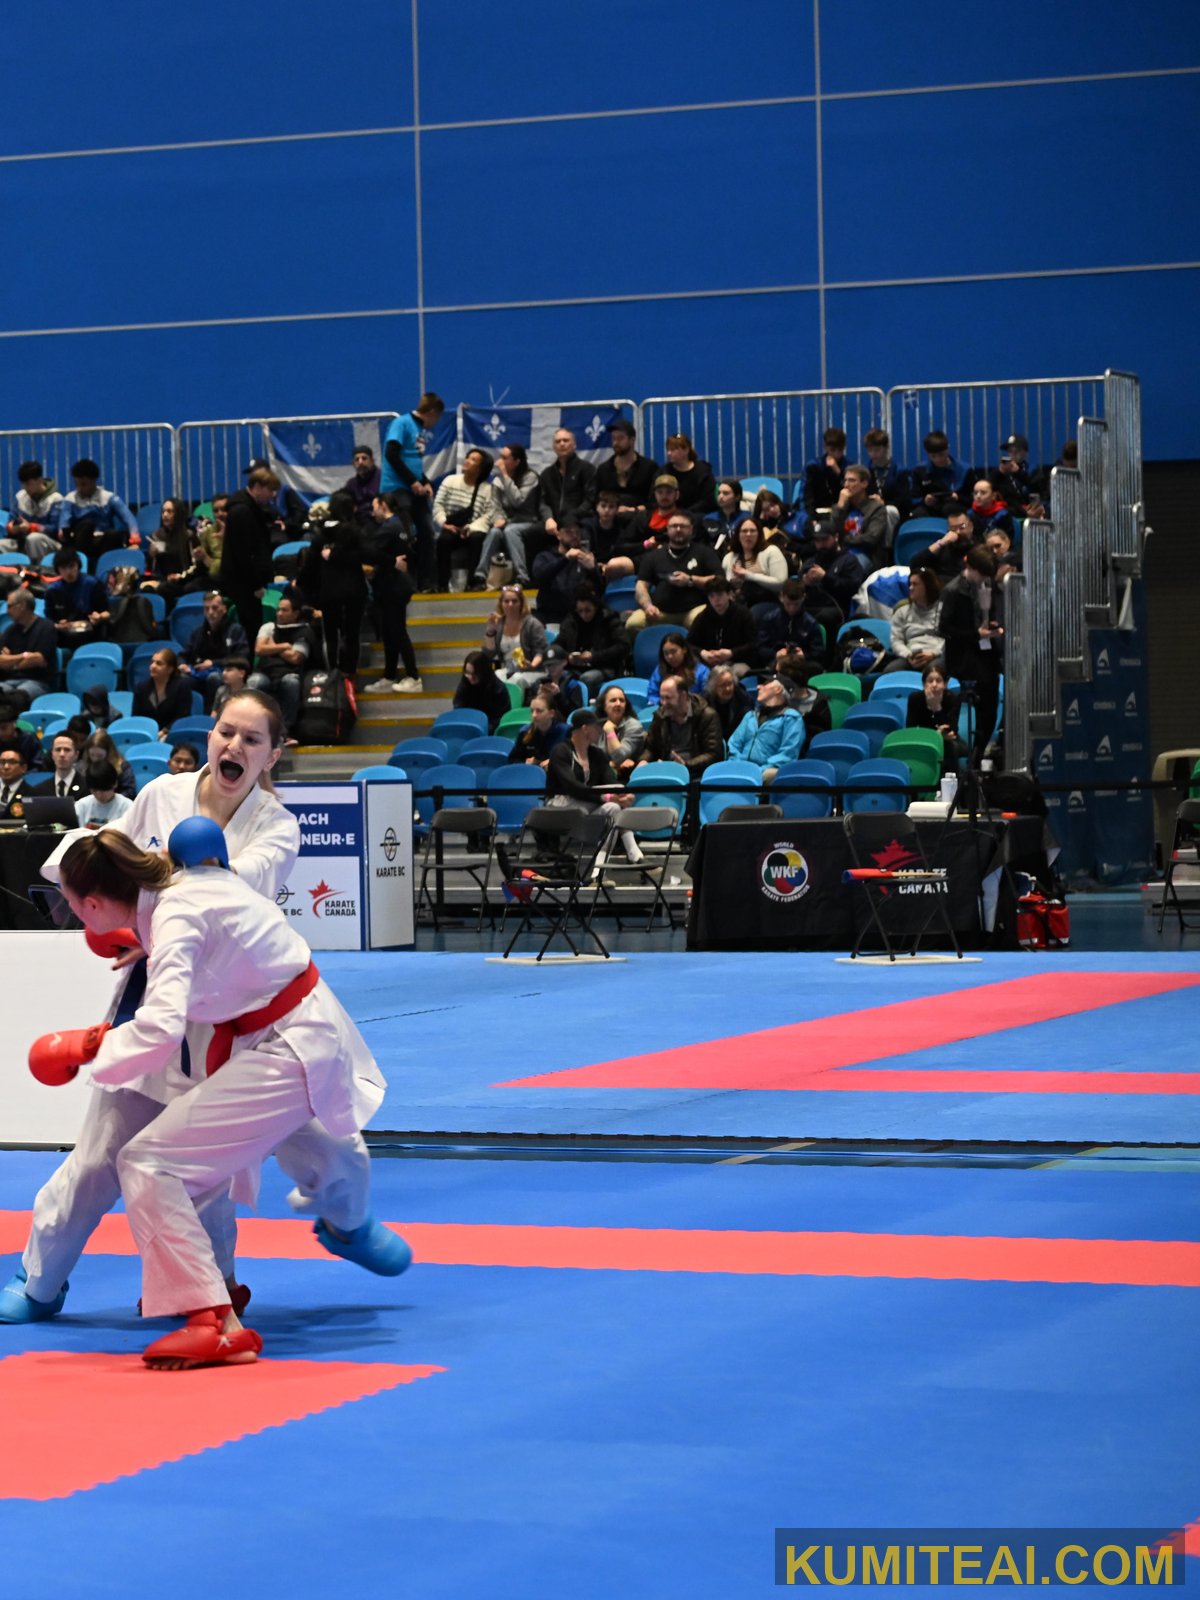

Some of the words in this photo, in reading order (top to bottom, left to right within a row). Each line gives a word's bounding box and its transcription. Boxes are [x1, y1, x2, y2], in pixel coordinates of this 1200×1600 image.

[298, 813, 329, 825] ACH
[301, 833, 355, 845] NEUR·E
[773, 841, 794, 849] WORLD
[376, 867, 397, 878] KARATE
[398, 866, 405, 876] BC
[770, 866, 799, 878] WKF
[761, 886, 780, 902] KARATE
[325, 900, 355, 908] KARATE
[290, 908, 303, 916] BC
[325, 908, 356, 916] CANADA
